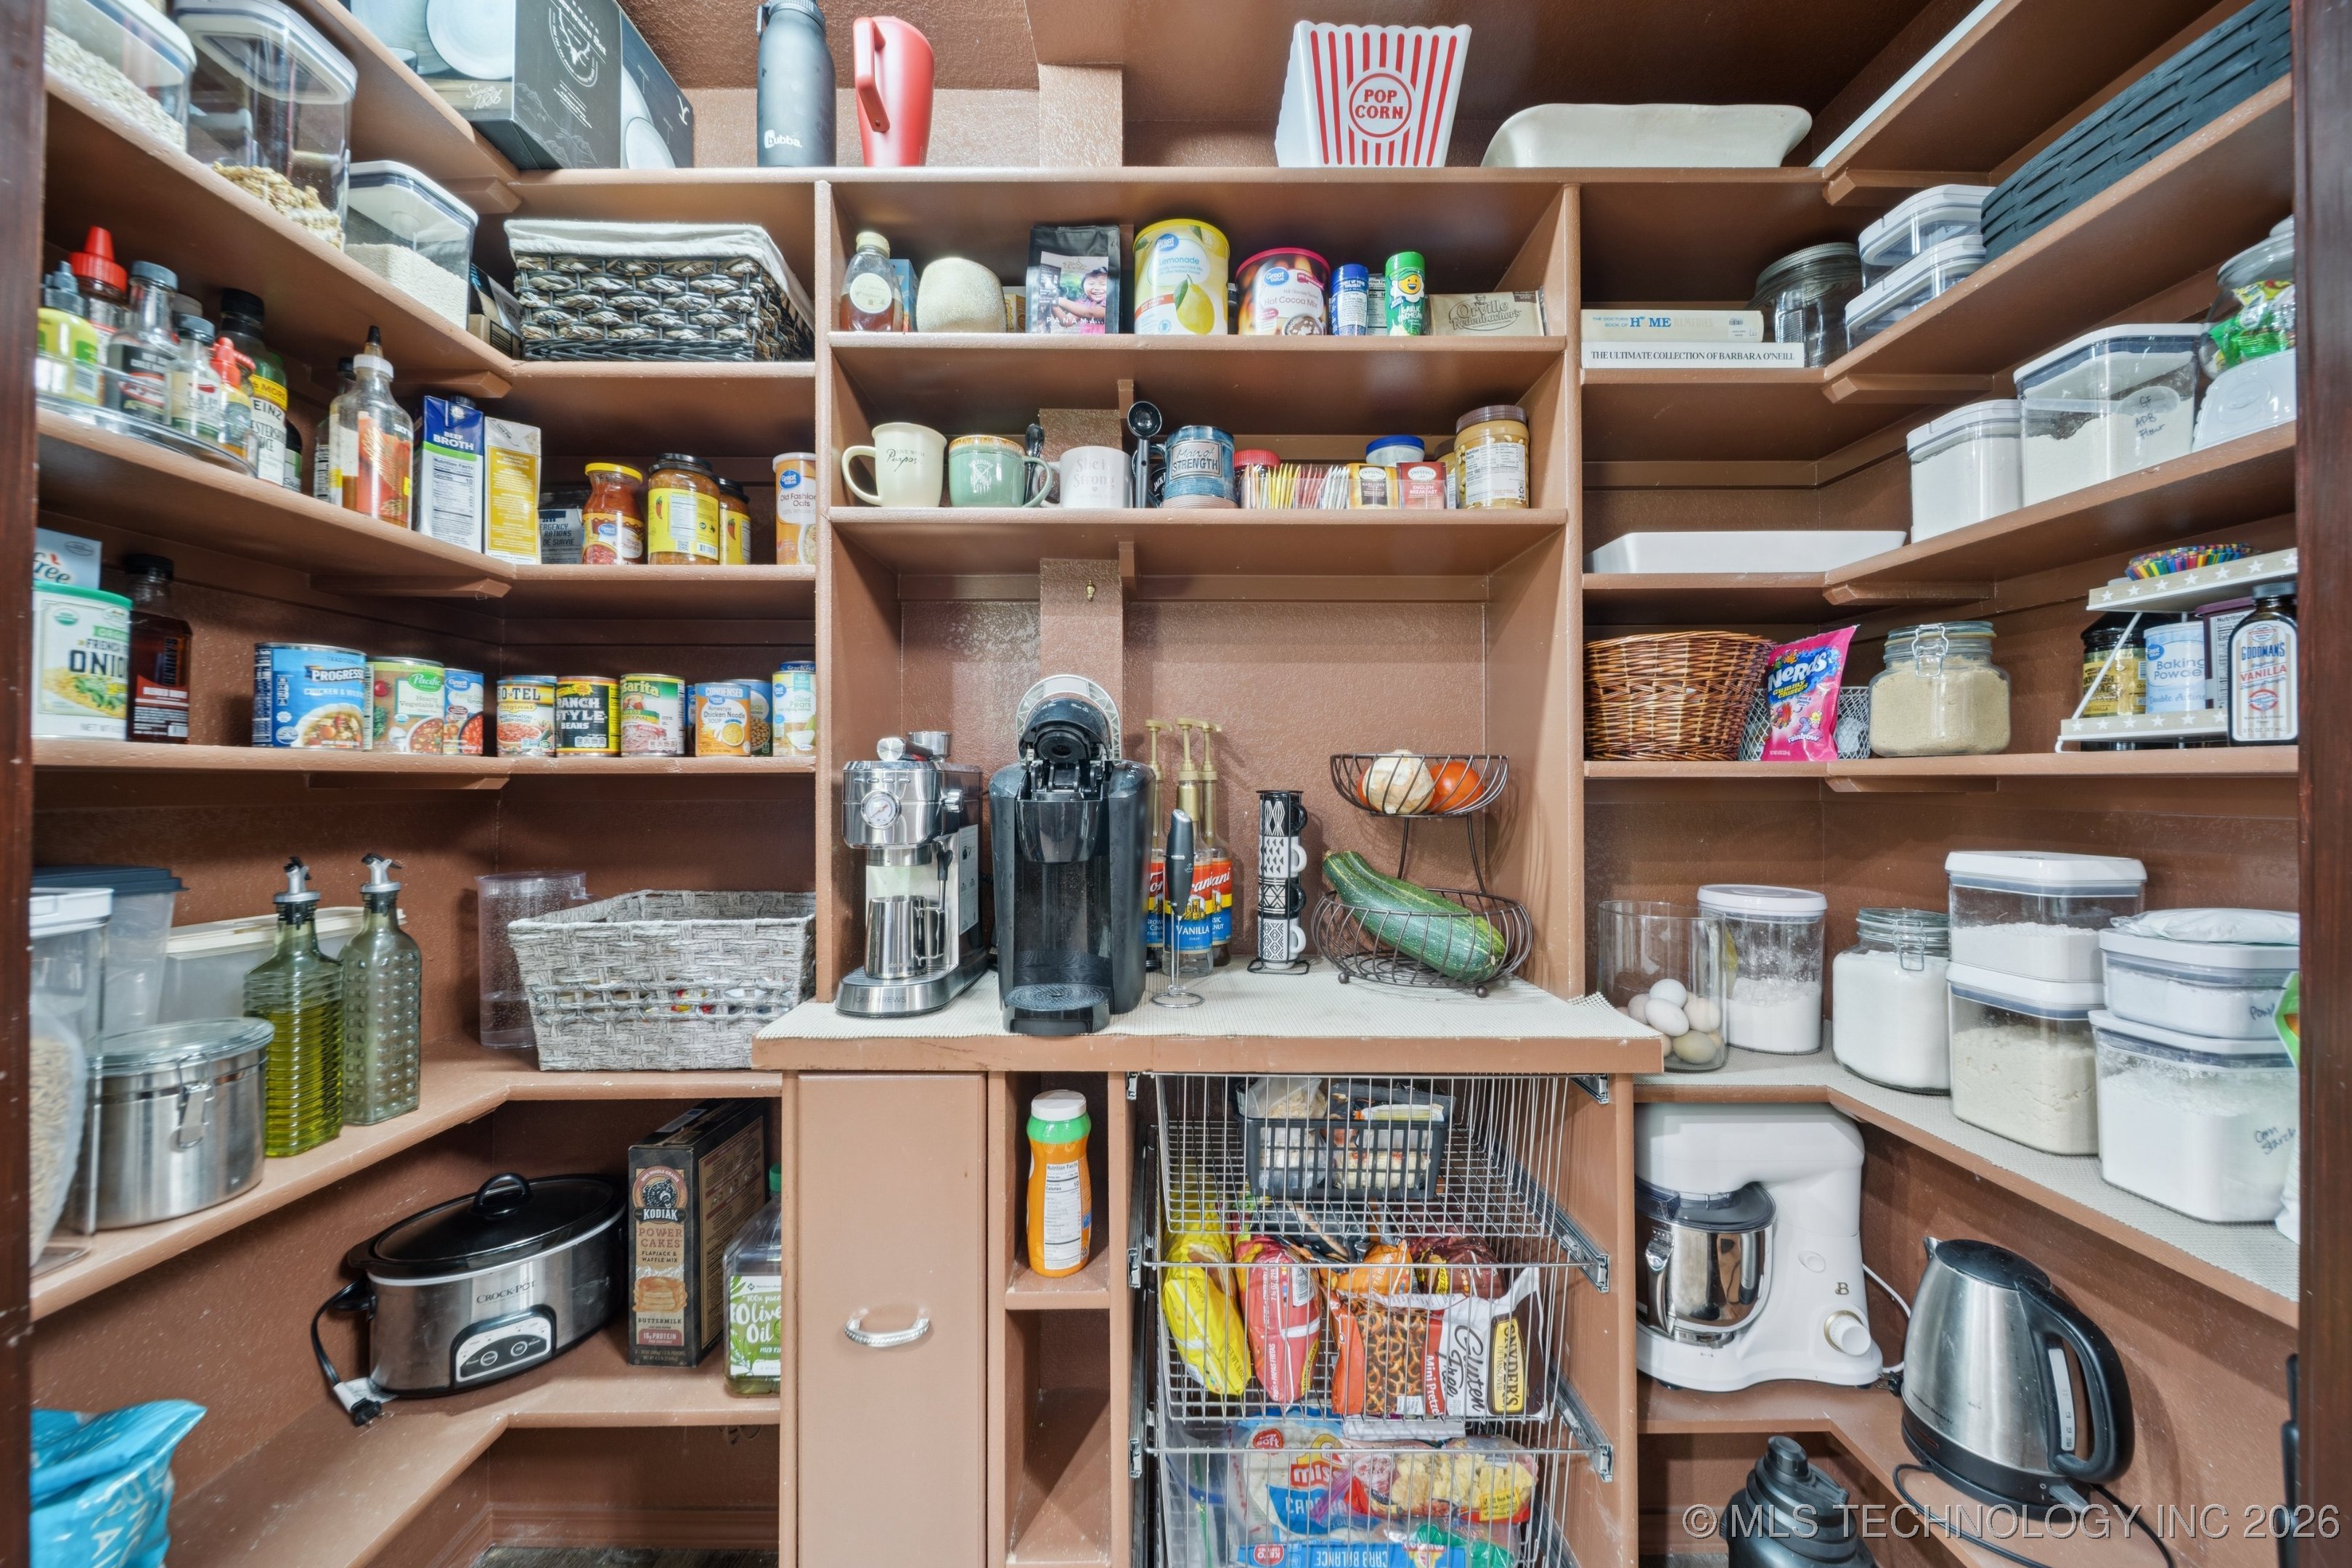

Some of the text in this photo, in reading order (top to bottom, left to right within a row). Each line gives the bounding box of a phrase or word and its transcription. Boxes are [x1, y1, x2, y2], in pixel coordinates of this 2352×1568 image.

[1363, 89, 1397, 103] POP
[1355, 105, 1403, 119] CORN
[1159, 256, 1200, 265] Lemonade
[1279, 296, 1306, 305] Cocoa
[1307, 299, 1318, 309] Mix
[1457, 300, 1509, 319] Orville
[253, 400, 282, 421] EINZ
[444, 430, 464, 440] BEEF
[433, 433, 475, 451] BROTH
[1177, 446, 1214, 459] Man of
[1172, 457, 1219, 473] STRENGTH
[781, 474, 797, 483] Great
[311, 668, 364, 682] PROGRESS
[2155, 669, 2202, 680] Powde
[2239, 664, 2287, 682] VANILLA
[706, 686, 743, 697] CONDENSED
[557, 697, 600, 709] RANCH
[1788, 732, 1821, 743] rainbow
[1176, 926, 1209, 935] VANILLA
[643, 1208, 678, 1220] KODIAK
[638, 1228, 682, 1237] POWER
[640, 1238, 680, 1248] CAKES
[1835, 1282, 1850, 1295] B
[735, 1303, 781, 1325] Olive
[746, 1323, 774, 1344] Oil
[1497, 1345, 1503, 1355] OF
[1426, 1355, 1434, 1379] Mini
[1454, 1325, 1485, 1413] Gluten
[1503, 1323, 1519, 1408] SNYDER'S
[1435, 1348, 1465, 1398] Free
[1256, 1437, 1280, 1447] soft
[1315, 1550, 1360, 1567] BALANCE
